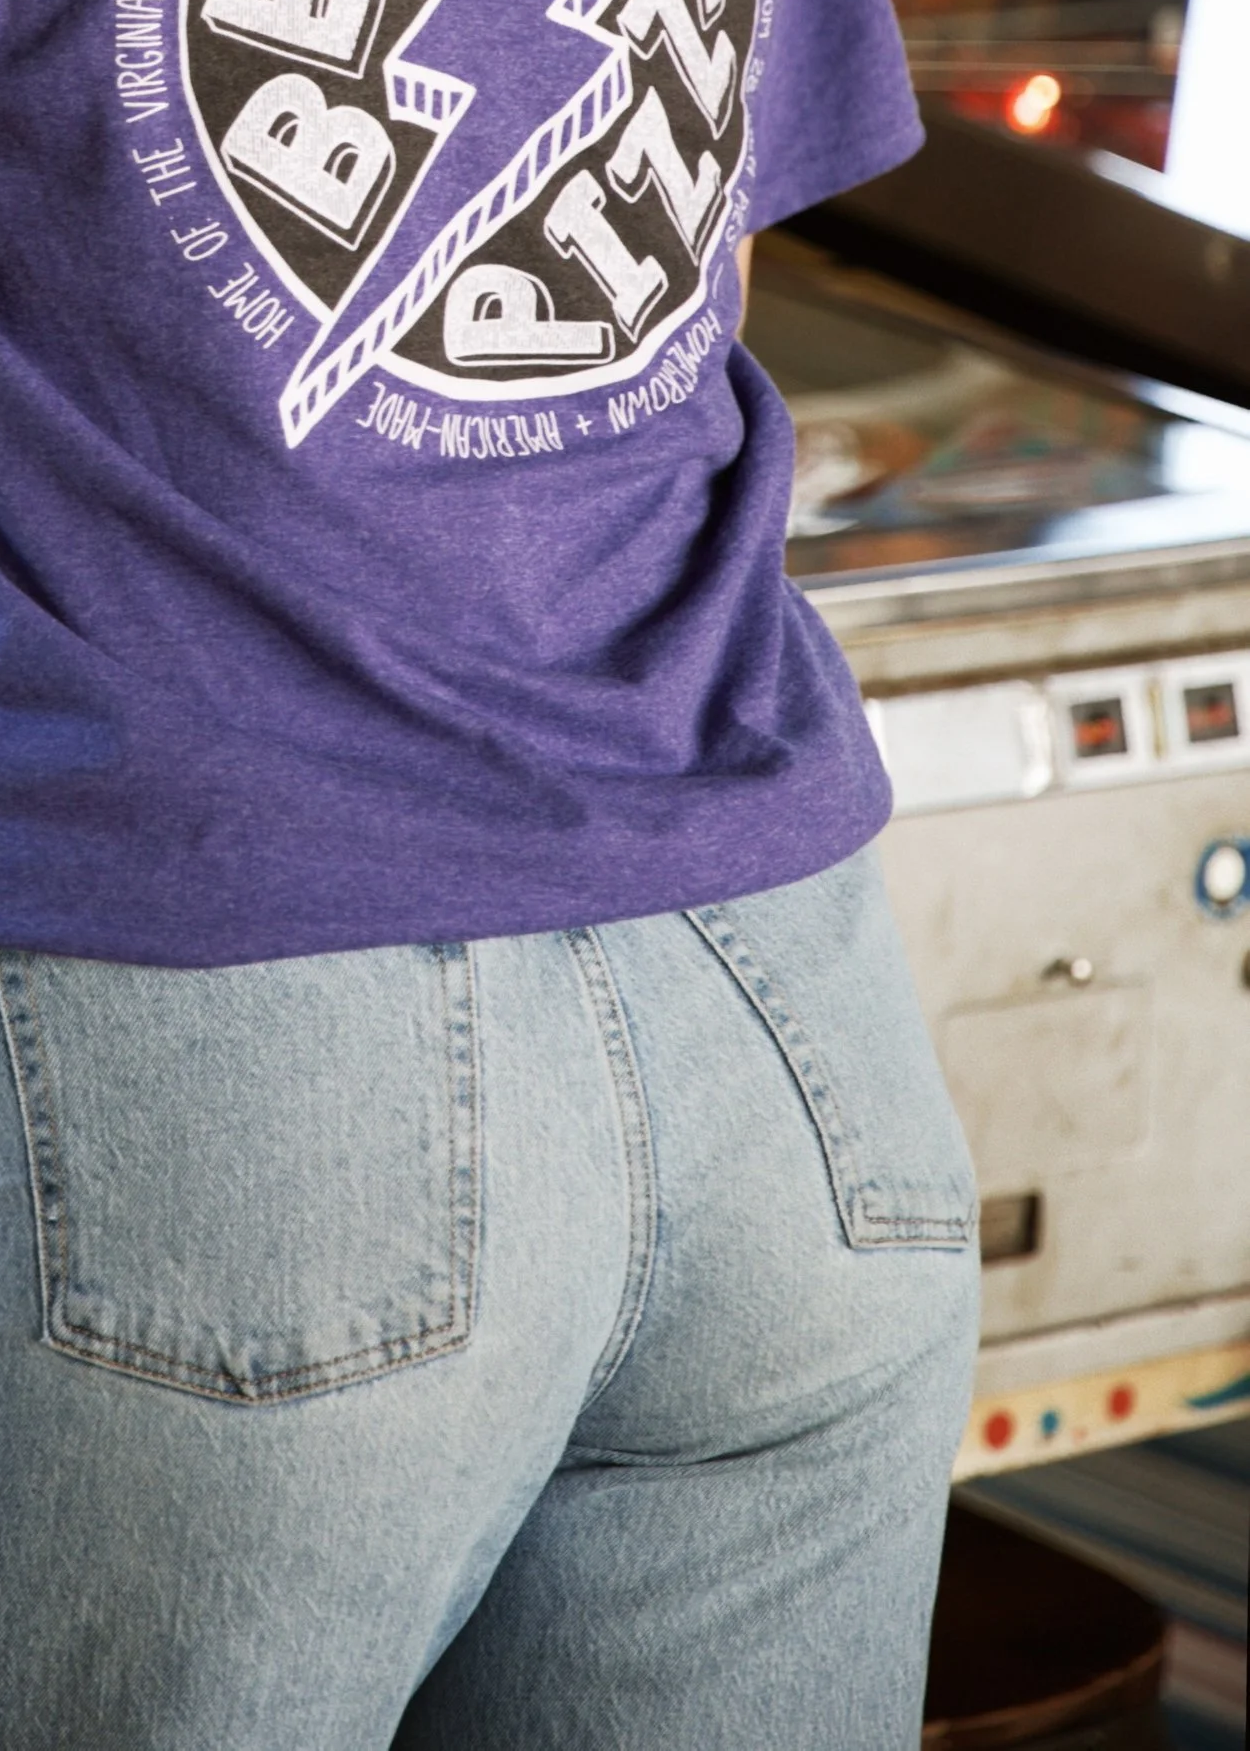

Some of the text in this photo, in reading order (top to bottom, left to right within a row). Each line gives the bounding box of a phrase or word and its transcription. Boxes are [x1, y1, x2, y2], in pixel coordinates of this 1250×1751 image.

[131, 137, 198, 207] THE
[169, 220, 229, 262] OF
[206, 261, 296, 350] HOME
[607, 307, 723, 435] HOMEGROWN
[354, 380, 565, 460] AMERICAN-MADE
